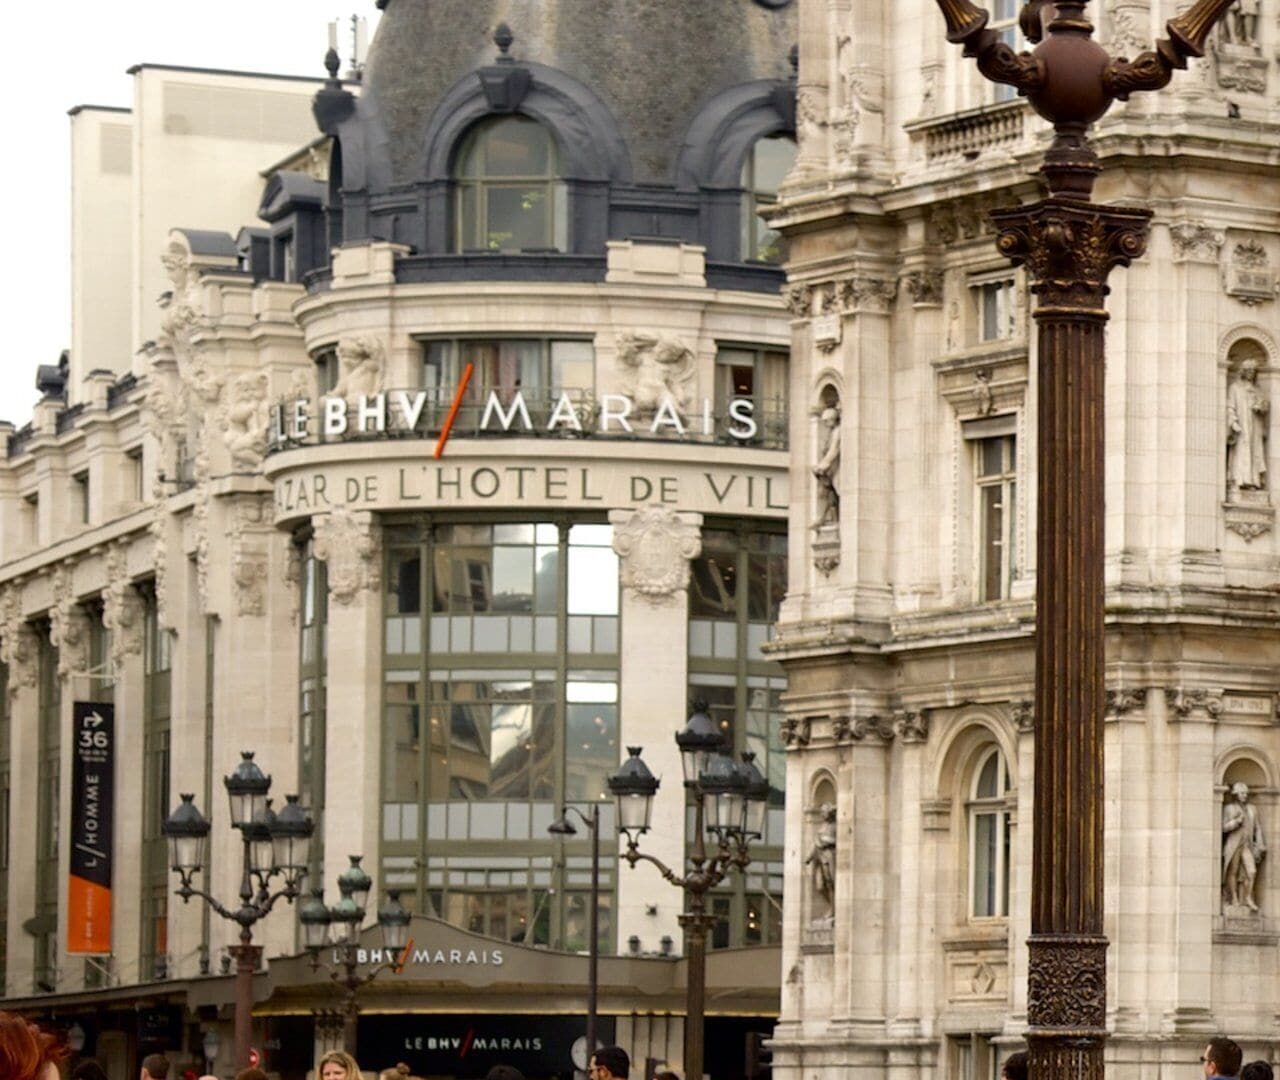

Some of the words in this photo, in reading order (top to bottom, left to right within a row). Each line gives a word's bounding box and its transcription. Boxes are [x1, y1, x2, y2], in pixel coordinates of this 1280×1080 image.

[275, 398, 310, 441] LE
[480, 390, 758, 440] MARAIS
[278, 474, 330, 511] ZAR
[345, 476, 378, 503] DE
[399, 466, 603, 500] L'HOTEL
[630, 475, 678, 504] DE
[704, 473, 789, 510] VIL
[79, 730, 108, 748] 36
[412, 949, 504, 965] MARAIS
[404, 1037, 423, 1050] LE
[472, 1037, 542, 1051] MARAIS
